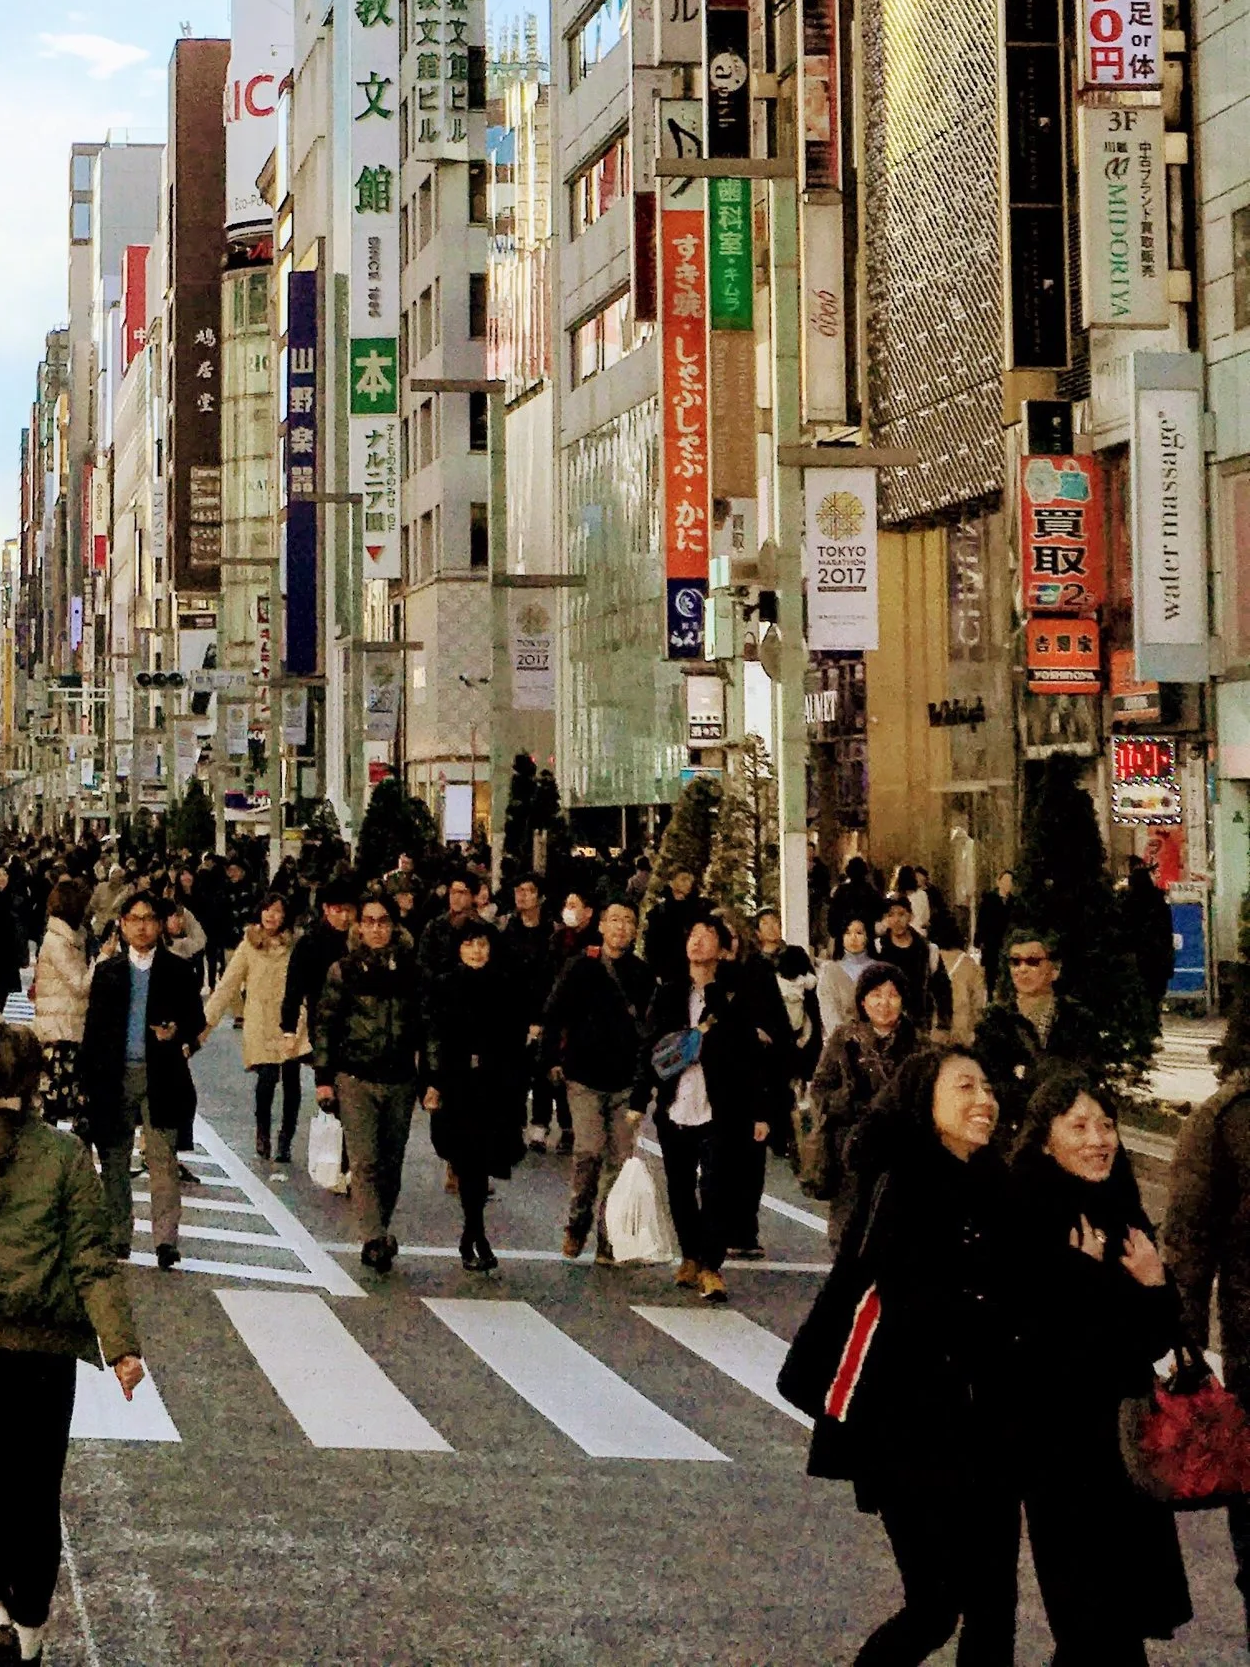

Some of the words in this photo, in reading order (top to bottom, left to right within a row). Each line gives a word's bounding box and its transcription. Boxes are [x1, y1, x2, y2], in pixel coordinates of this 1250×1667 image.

[1108, 111, 1138, 132] 3F
[1107, 184, 1132, 318] MIDORIYA
[195, 327, 218, 414] 鳩居堂
[354, 350, 393, 404] 本
[290, 347, 314, 494] 山野楽器
[817, 546, 866, 558] TOKYO
[1033, 508, 1088, 576] 買取
[817, 568, 866, 584] 2017
[1159, 543, 1181, 622] water
[517, 654, 550, 666] 2017
